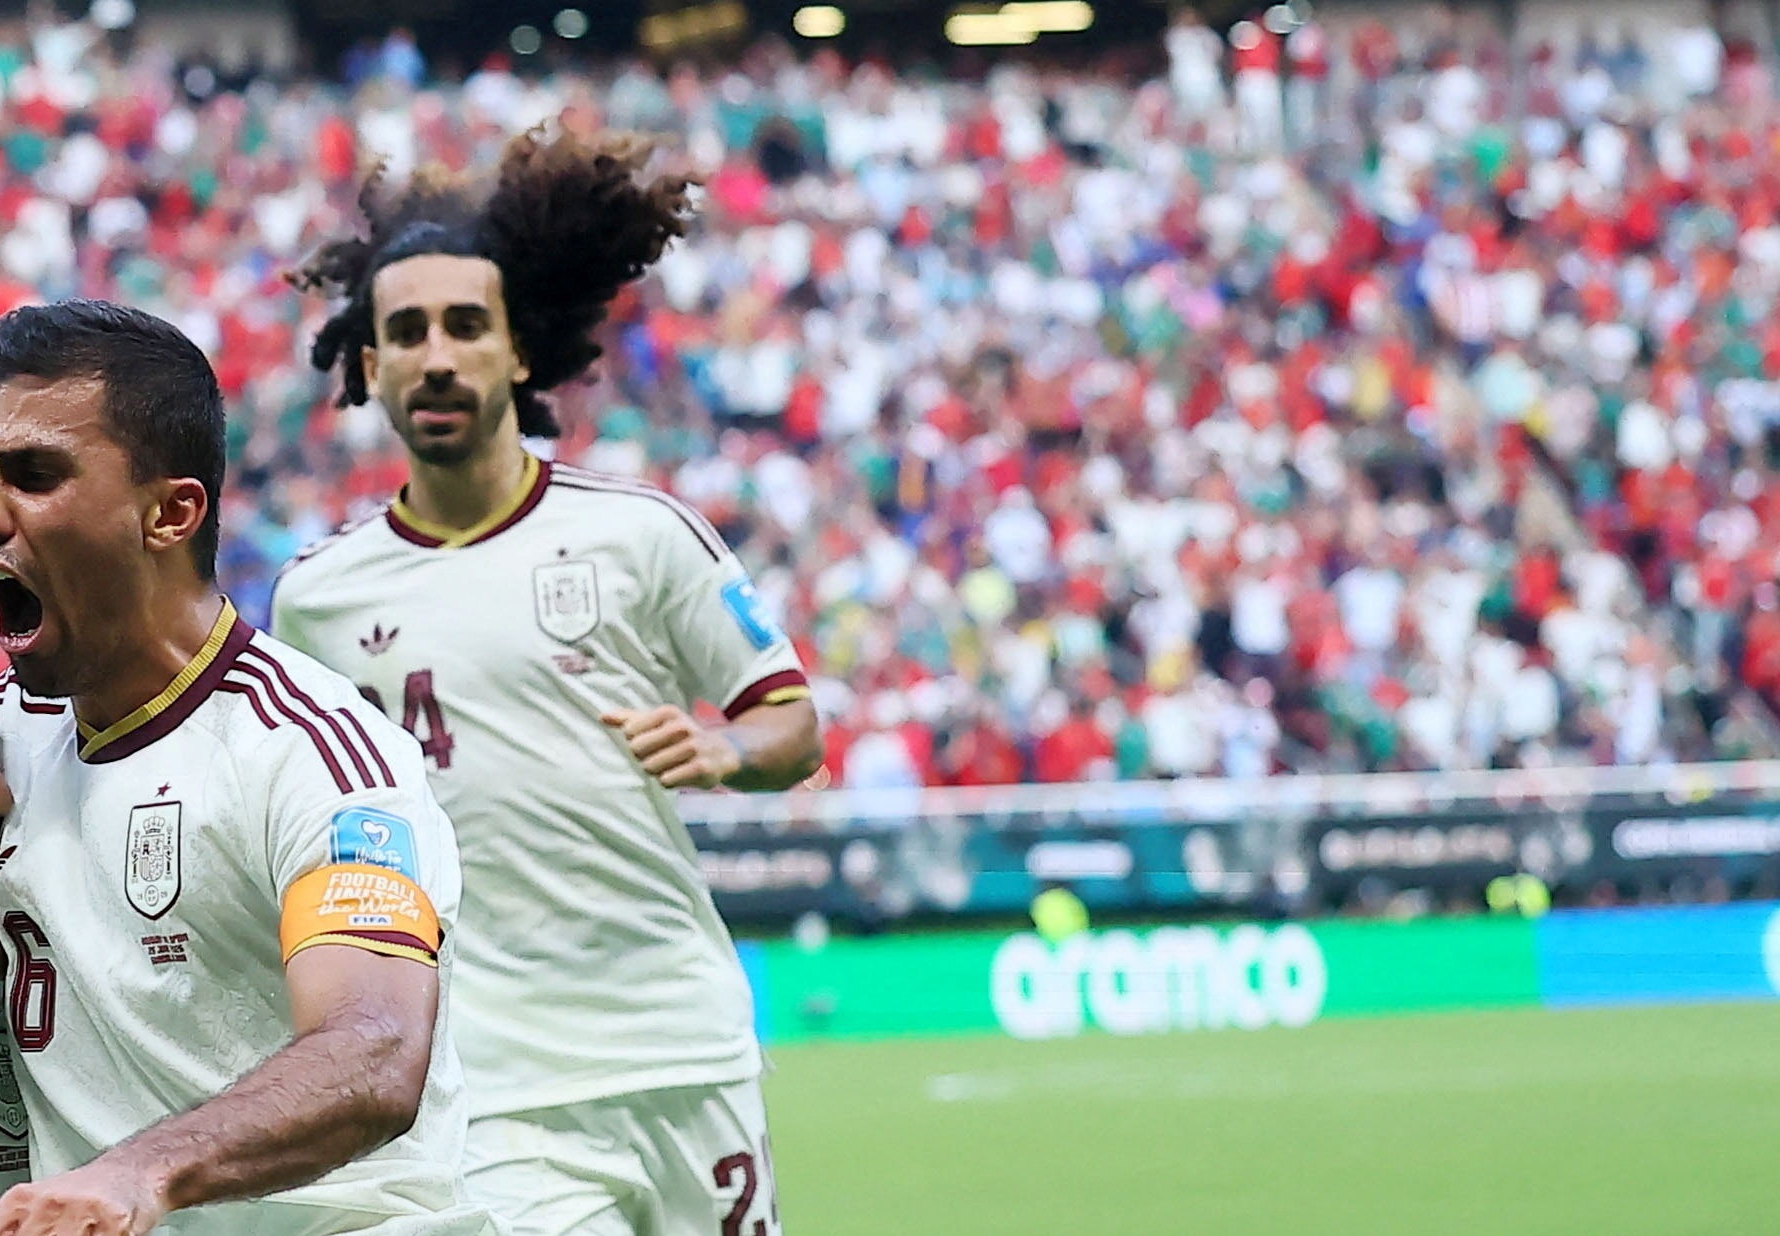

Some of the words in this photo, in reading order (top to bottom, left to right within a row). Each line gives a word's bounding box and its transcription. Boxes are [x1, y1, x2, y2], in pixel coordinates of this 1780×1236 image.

[358, 669, 454, 769] 4
[329, 873, 417, 903] FOOTBALL
[353, 916, 389, 924] FIFA
[990, 926, 1326, 1038] aramco
